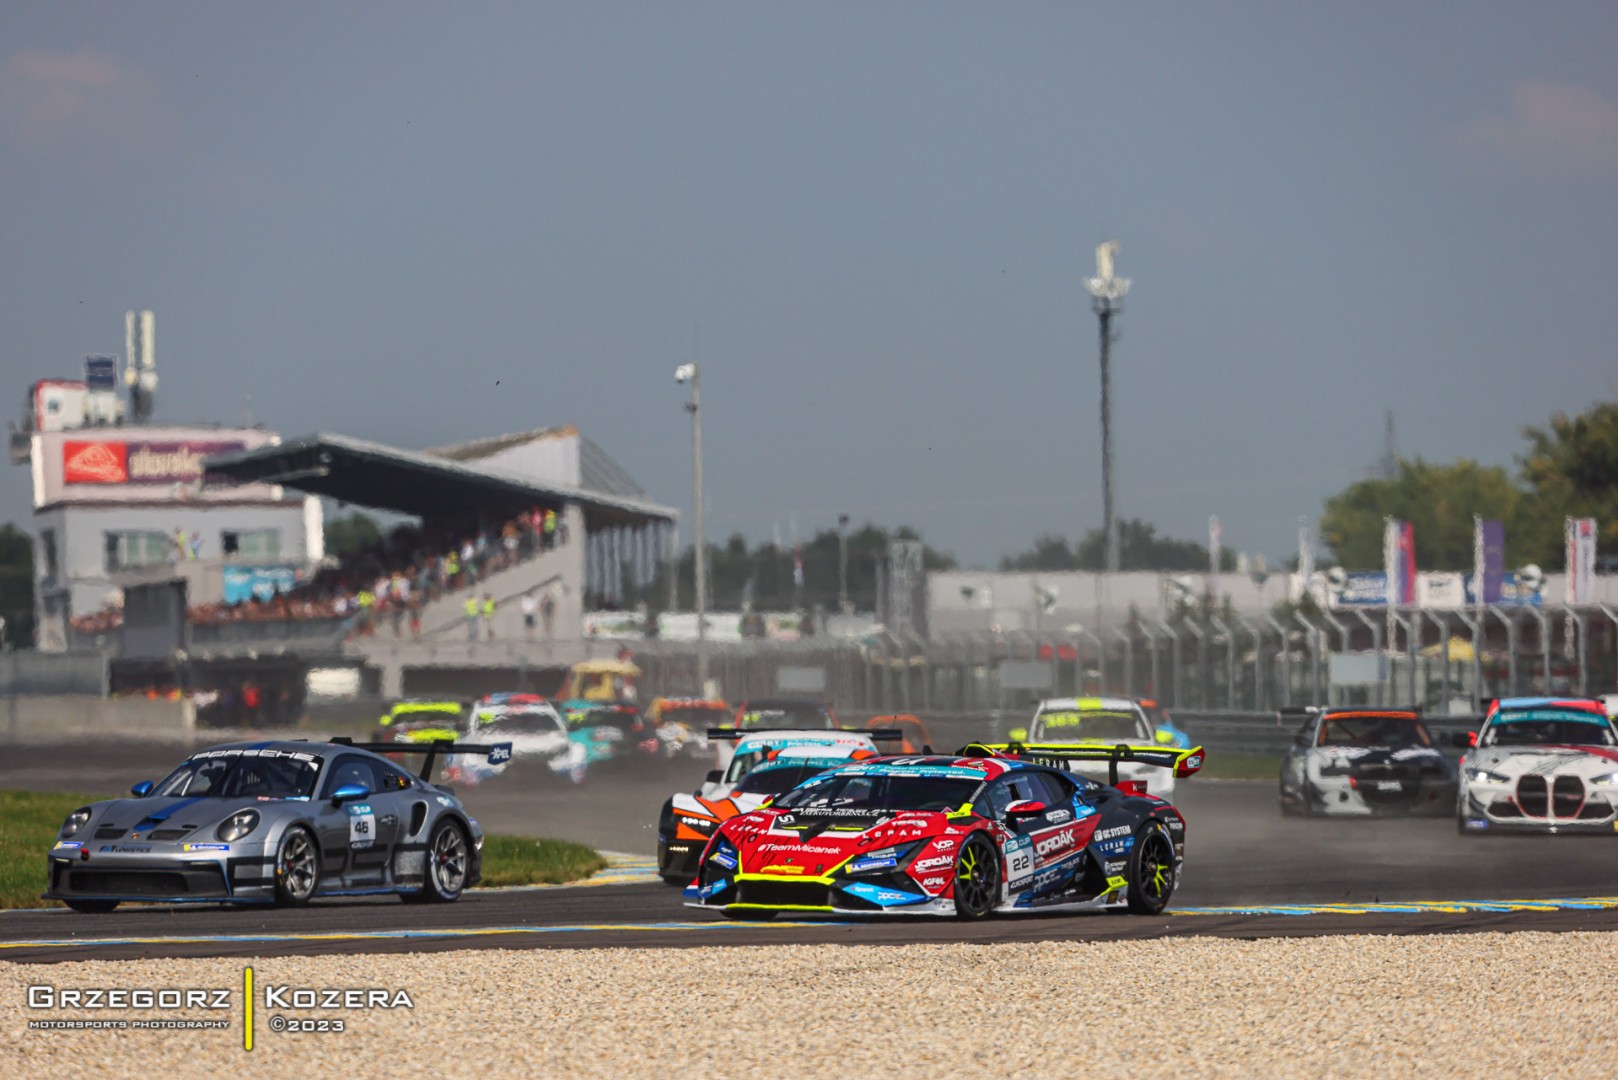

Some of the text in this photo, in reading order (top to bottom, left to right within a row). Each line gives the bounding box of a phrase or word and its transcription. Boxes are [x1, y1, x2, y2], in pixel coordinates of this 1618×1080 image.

[191, 749, 315, 762] PORSCHE
[491, 746, 510, 760] XPEL
[354, 821, 369, 834] 46
[862, 829, 922, 839] LERAM
[1110, 825, 1132, 838] SYSTEM
[1019, 837, 1031, 847] CUP
[757, 843, 841, 855] #TeamMicanek
[1012, 855, 1030, 872] 22
